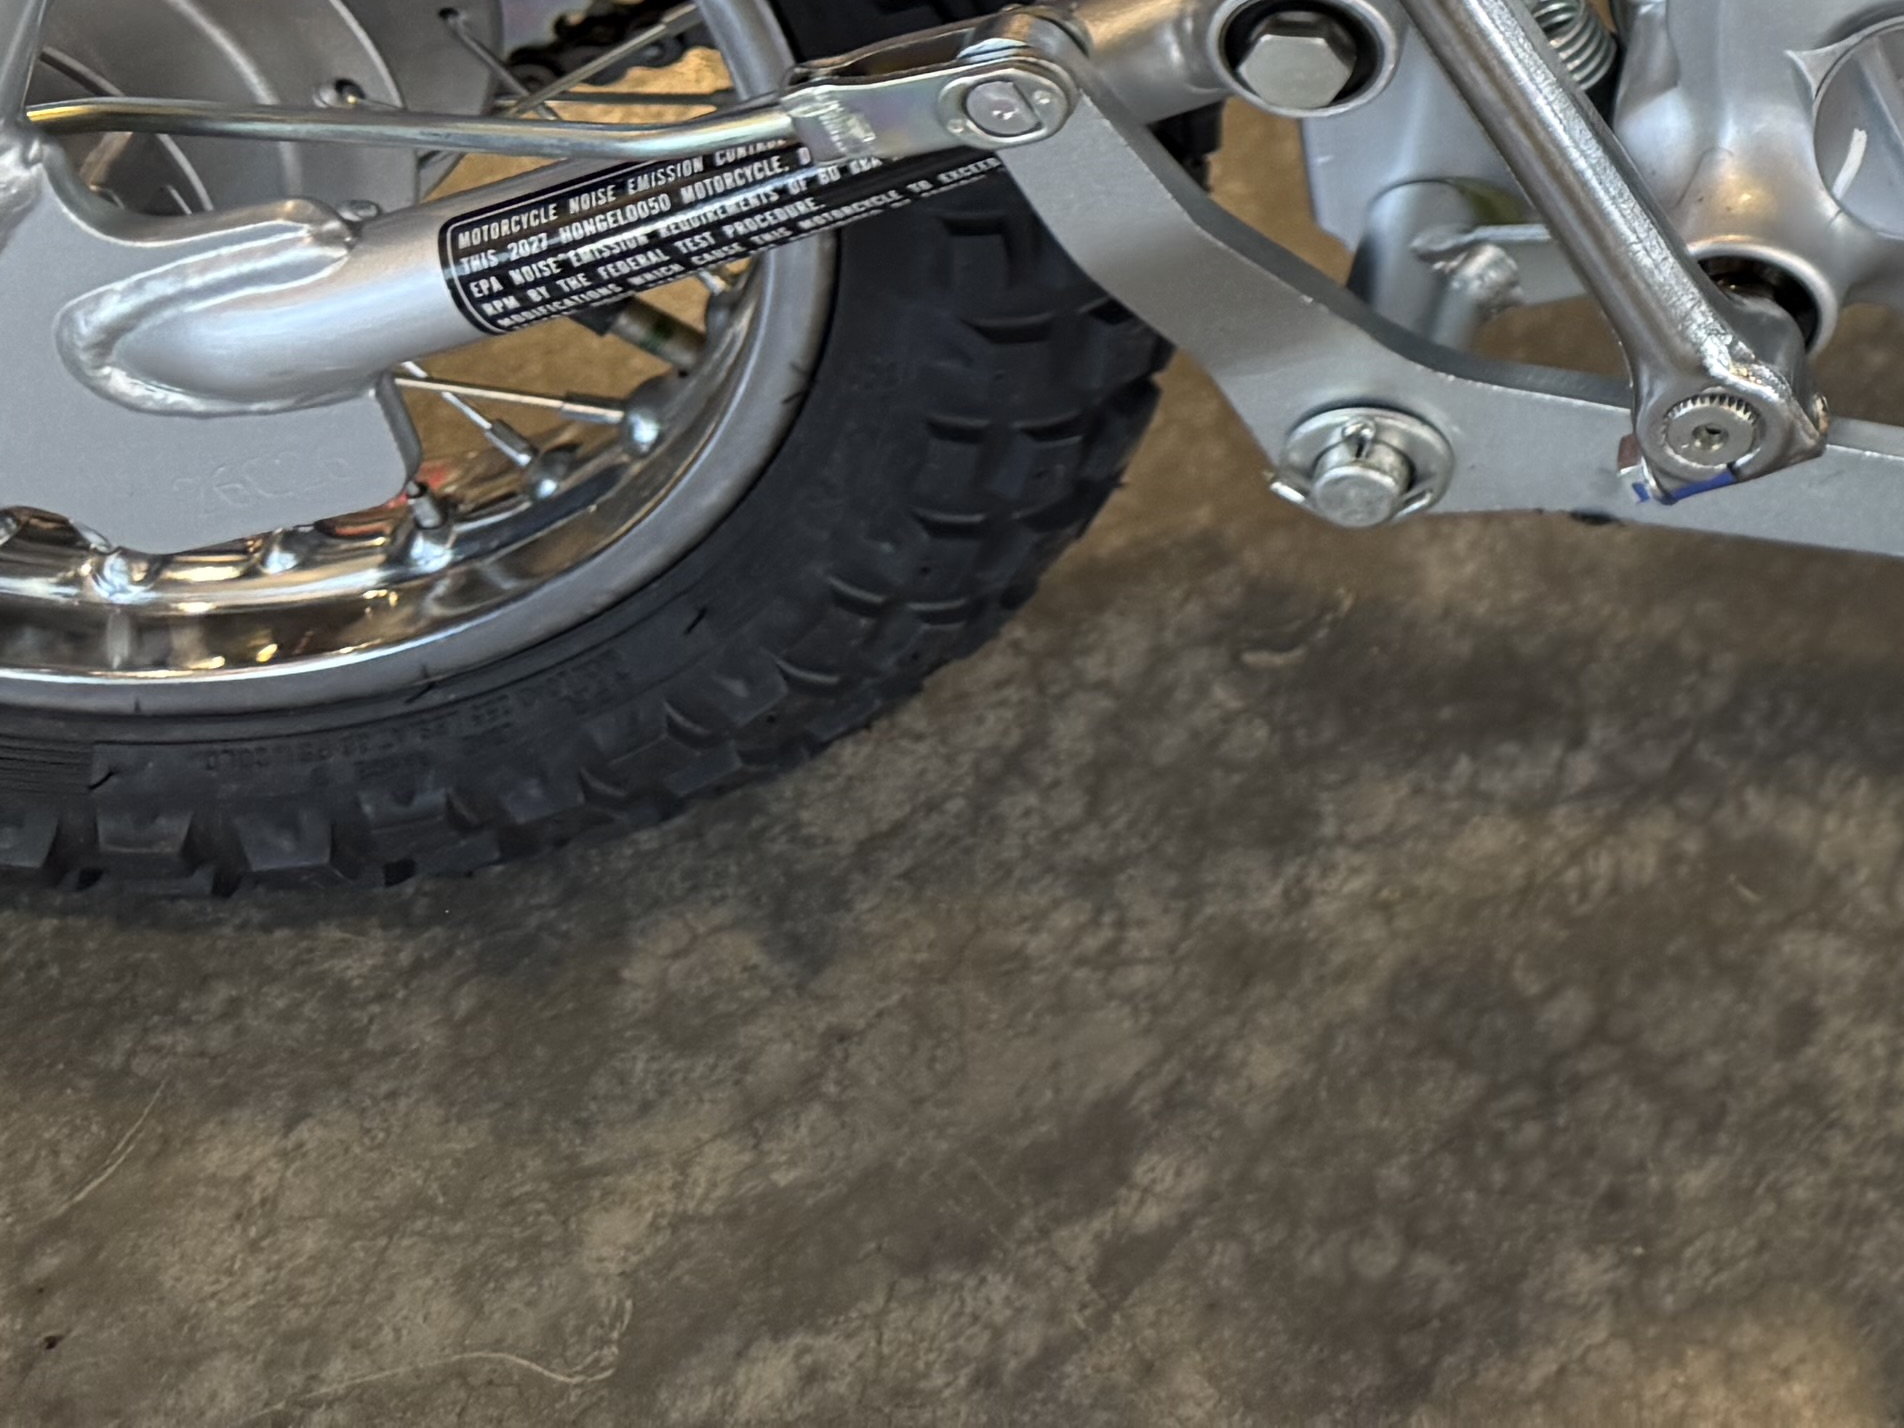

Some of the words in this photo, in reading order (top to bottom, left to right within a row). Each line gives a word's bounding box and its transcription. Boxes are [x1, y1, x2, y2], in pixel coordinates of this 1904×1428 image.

[457, 203, 558, 249] MOTORCYCLE
[568, 184, 617, 215] NOISE
[627, 154, 704, 196] EMISSION
[469, 275, 504, 298] EPA
[509, 255, 561, 286] NOISE
[569, 230, 649, 267] EMISSION
[659, 186, 780, 239] REQUIREMENTS
[788, 176, 811, 196] OF
[481, 297, 521, 317] RPM
[527, 285, 551, 302] BY
[557, 272, 589, 293] THE
[598, 248, 671, 281] FEDERAL
[674, 231, 717, 256] TEST
[722, 195, 827, 240] PROCEDURE.
[497, 284, 623, 328] MODIFICATIONS
[628, 263, 685, 286] WHICH
[690, 244, 748, 267] CAUSE
[750, 228, 793, 246] THIS
[797, 189, 903, 232] MOTORCYCLE
[906, 179, 933, 193] TO
[460, 252, 503, 274] THIS
